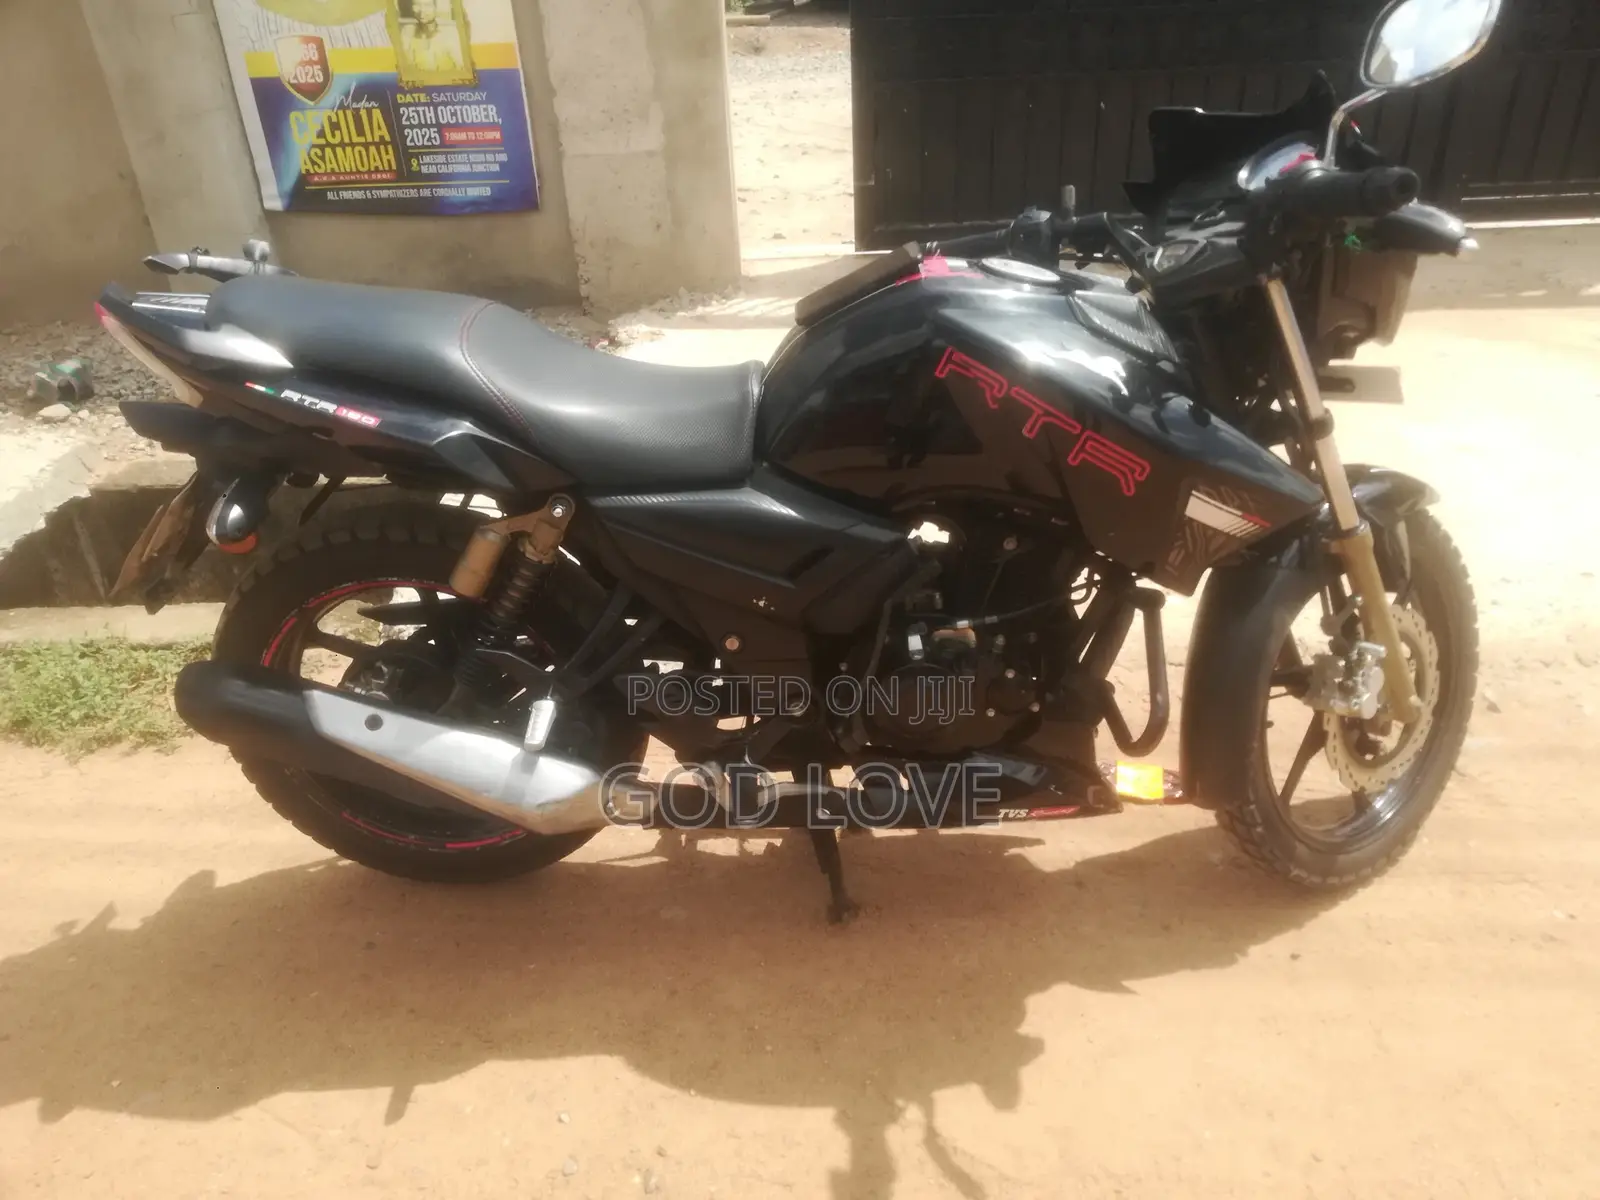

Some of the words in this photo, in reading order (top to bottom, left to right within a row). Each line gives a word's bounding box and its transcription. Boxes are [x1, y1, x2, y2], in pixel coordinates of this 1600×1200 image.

[397, 93, 430, 103] DATE:
[431, 91, 487, 102] SATURDAY
[400, 106, 436, 125] 25TH
[437, 104, 502, 125] OCTOBER,
[289, 108, 391, 145] CECILIA
[404, 127, 441, 146] 2025
[301, 144, 397, 174] ASAMOAH
[326, 190, 339, 201] ALL
[339, 190, 366, 200] FRIENDS
[419, 188, 433, 197] ARE
[935, 346, 1150, 496] RTR
[997, 808, 1029, 818] TVS
